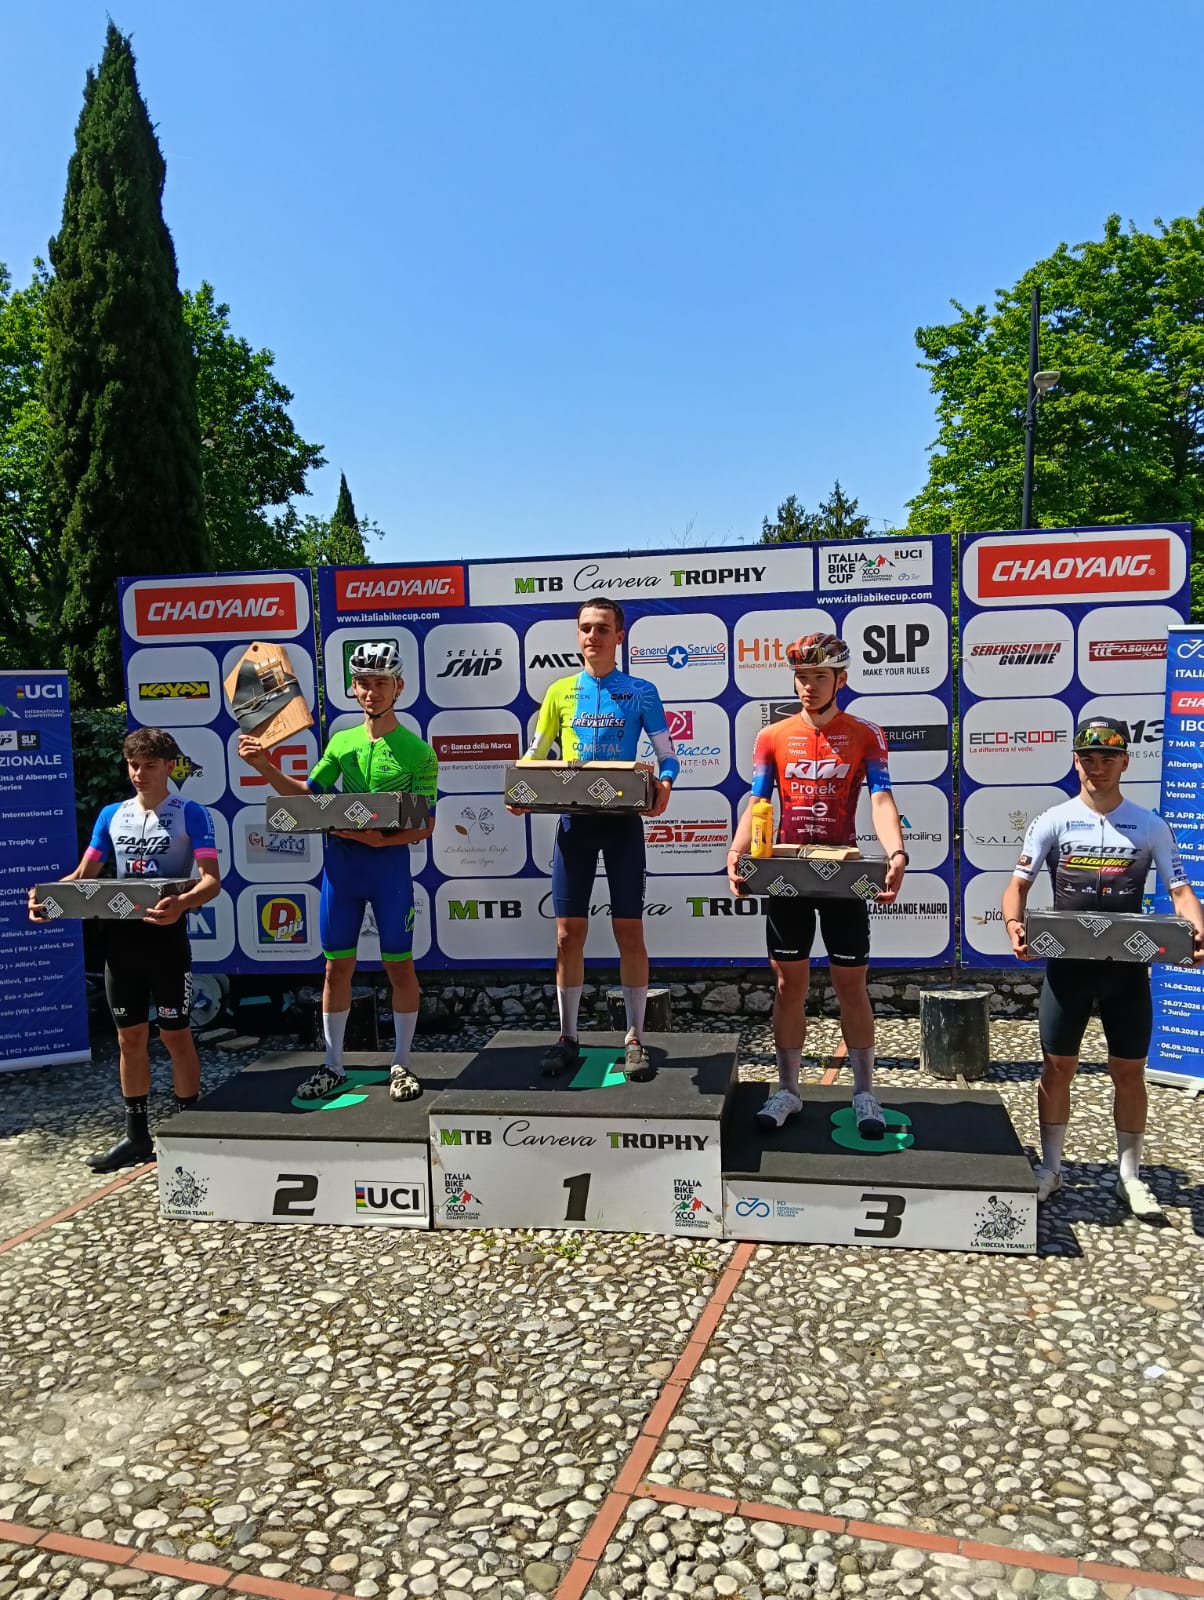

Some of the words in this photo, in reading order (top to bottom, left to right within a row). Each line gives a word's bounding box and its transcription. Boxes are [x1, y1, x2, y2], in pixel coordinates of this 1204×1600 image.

[828, 552, 867, 563] ITALIA
[900, 549, 922, 559] UCI
[828, 563, 855, 573] BIKE
[862, 568, 880, 576] XCO
[992, 554, 1151, 582] CHAOYANG
[515, 577, 563, 594] MTB
[574, 564, 661, 591] Caneva
[670, 567, 766, 587] TROPHY
[828, 574, 853, 584] CUP
[346, 578, 452, 598] CHAOYANG
[817, 592, 932, 604] www.italiabikecup.com
[147, 597, 279, 622] CHAOYANG
[337, 612, 440, 623] www.italiabikecup.com
[863, 624, 930, 664] SLP
[446, 649, 502, 657] SELLE
[630, 645, 667, 655] General
[437, 658, 502, 677] SMP
[862, 668, 883, 677] MAKE
[885, 668, 905, 676] YOUR
[907, 667, 930, 675] RULES
[25, 684, 62, 698] UCI
[141, 682, 208, 697] KAYAK
[1178, 697, 1204, 708] CHA
[21, 735, 36, 744] SLP
[886, 730, 926, 741] ERLIGHT
[969, 730, 1067, 745] ECO-ROOF
[676, 743, 720, 756] Bacco
[785, 758, 851, 780] KTM
[1168, 761, 1203, 769] Albenga
[791, 782, 836, 795] Protek
[8, 838, 35, 847] Trophy
[116, 836, 171, 845] SANTA
[902, 832, 942, 842] etailing
[975, 835, 1025, 844] SALA
[125, 845, 171, 855] CRUZ
[1074, 845, 1142, 855] SCOTT
[126, 859, 158, 873] TSA
[1070, 856, 1132, 867] GAGABIKE
[448, 900, 522, 920] MTB
[869, 903, 918, 914] CASAGRANDE
[919, 903, 947, 914] MAURO
[182, 971, 192, 1015] SANTA
[440, 1129, 492, 1146] MTB
[502, 1119, 597, 1147] Caneva
[607, 1132, 709, 1151] TROPHY
[674, 1179, 702, 1187] ITALIA
[272, 1173, 318, 1216] 2
[368, 1187, 419, 1210] UCI
[563, 1173, 591, 1221] 1
[675, 1211, 695, 1220] XCO
[854, 1193, 906, 1239] 3
